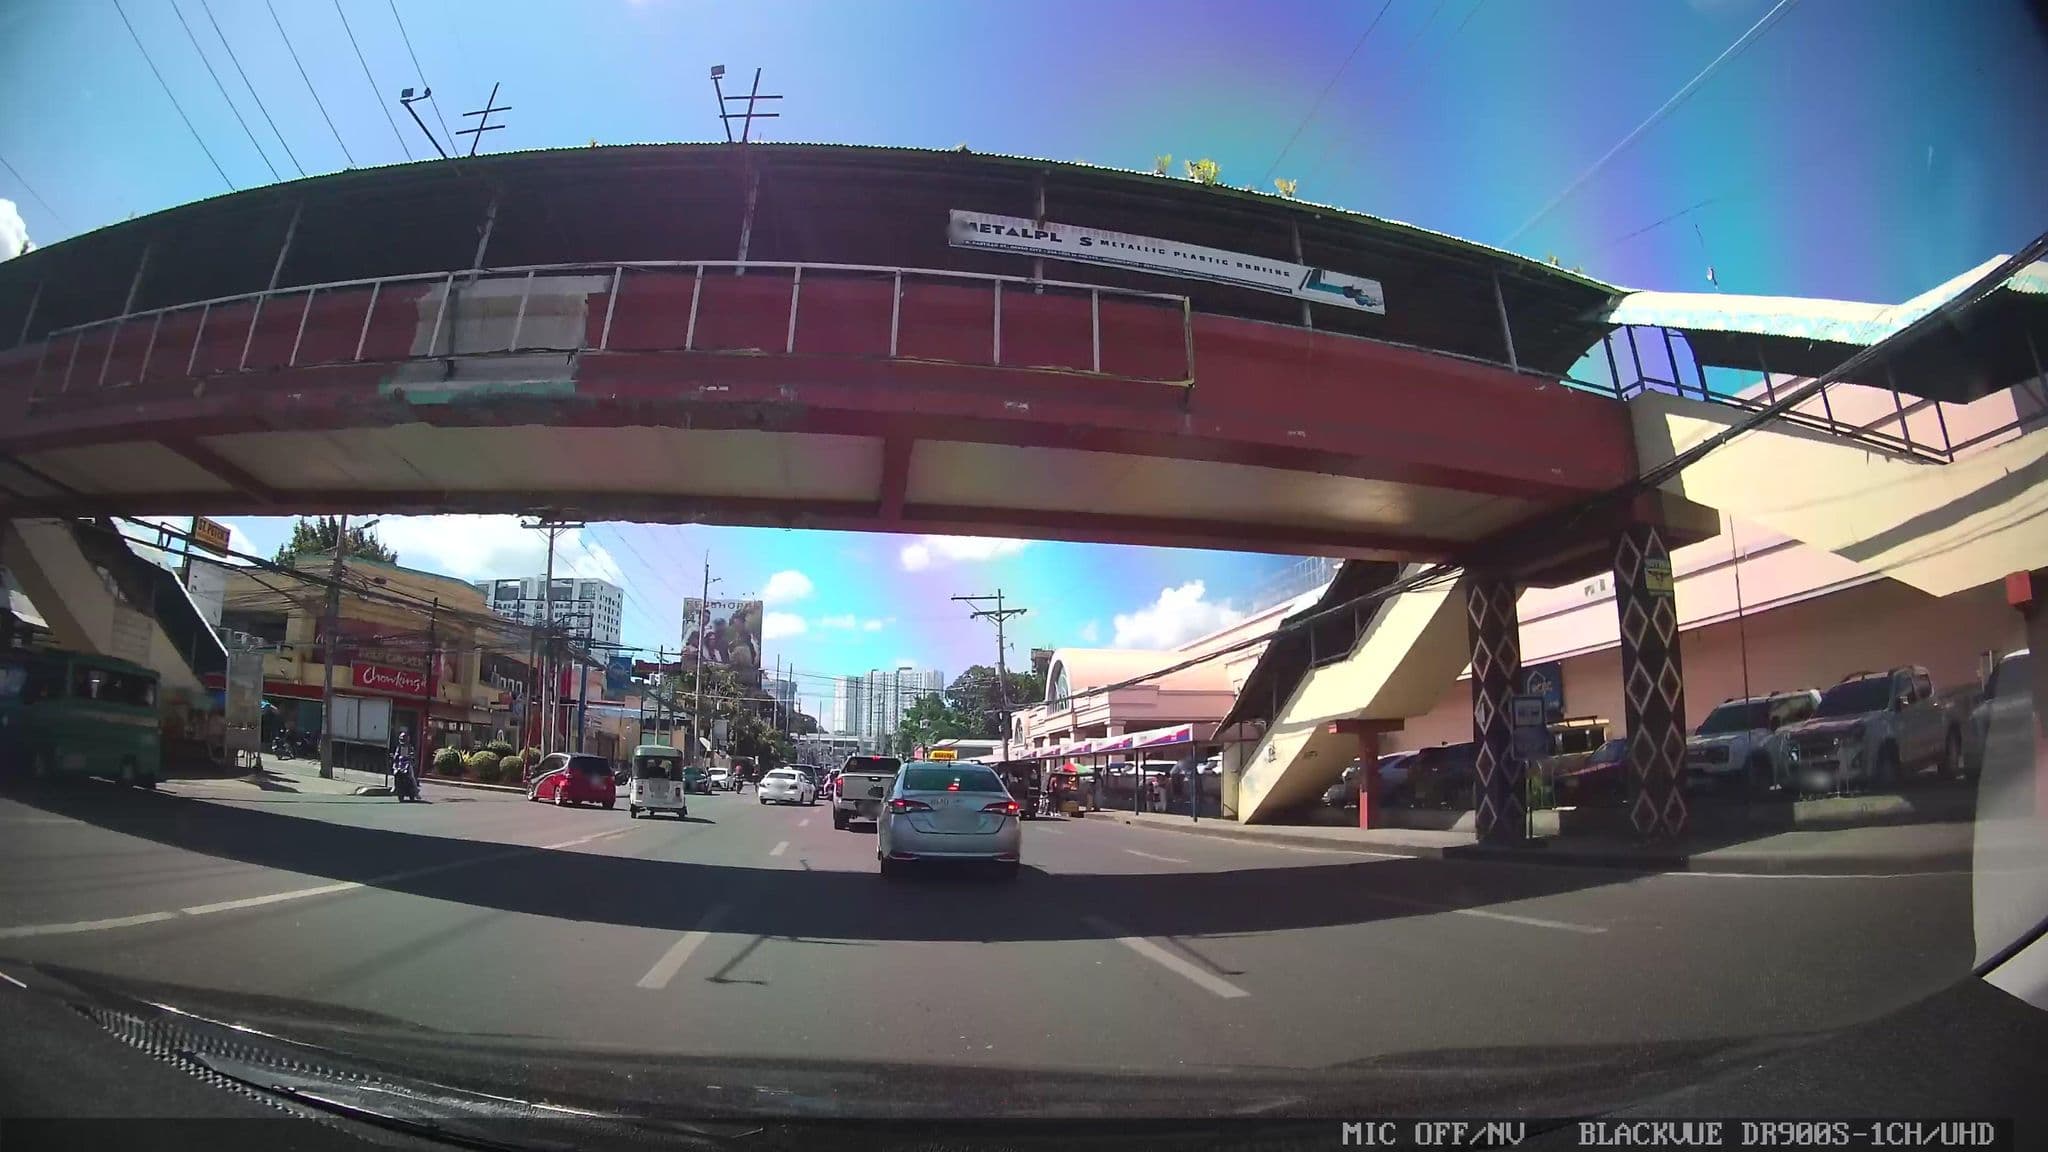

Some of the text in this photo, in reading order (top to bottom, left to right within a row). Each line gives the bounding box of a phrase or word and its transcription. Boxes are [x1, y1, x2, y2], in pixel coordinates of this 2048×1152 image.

[1100, 239, 1165, 255] METALLIC
[1174, 250, 1228, 266] PLASTIC
[362, 666, 422, 692] Chowking
